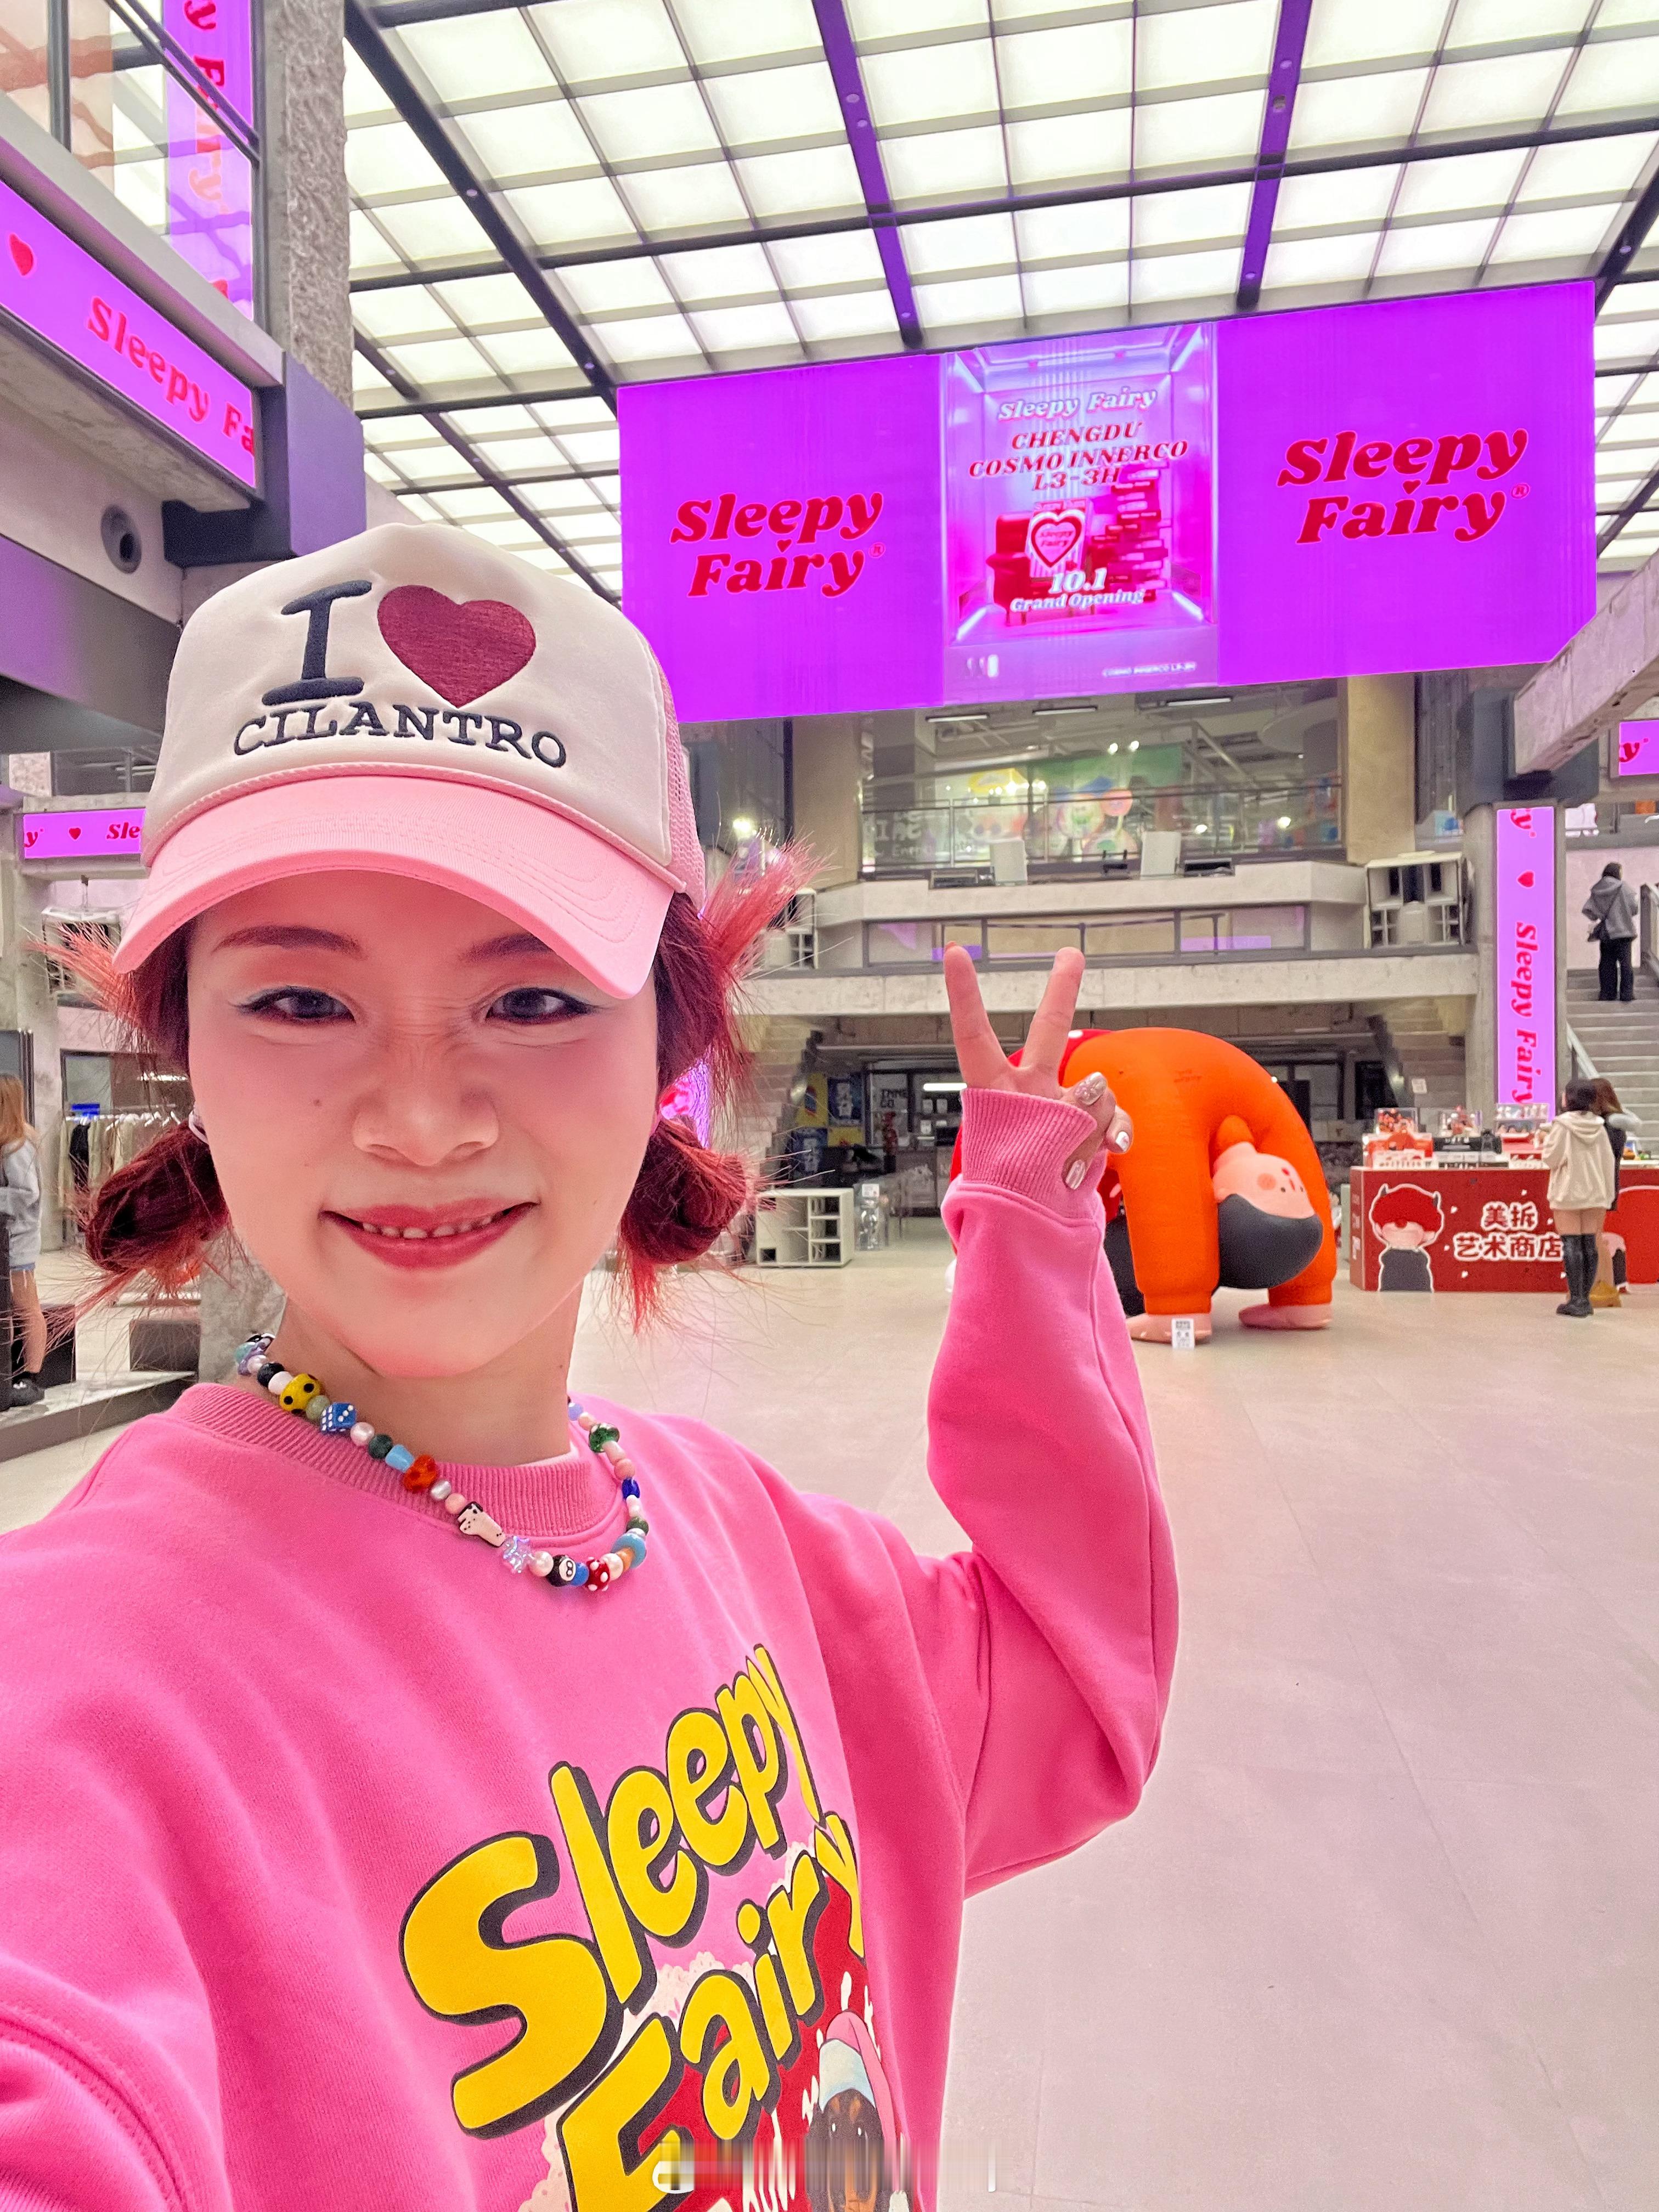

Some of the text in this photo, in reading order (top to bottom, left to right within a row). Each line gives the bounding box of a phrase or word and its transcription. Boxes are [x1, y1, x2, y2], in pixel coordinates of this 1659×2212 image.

[87, 296, 211, 422] Sleepy
[999, 387, 1157, 420] Sleepy Fairy
[969, 440, 1188, 477] COSMO INNERCO
[1011, 421, 1142, 450] CHENGDU
[1277, 429, 1527, 486] Sleepy
[670, 493, 883, 544] Sleepy
[1010, 589, 1146, 612] Grand Opening
[1049, 568, 1107, 594] 10.1
[262, 579, 372, 706] I
[233, 701, 567, 769] CILANTRO
[1511, 922, 1538, 1018] Sleepy
[1482, 1202, 1537, 1230] 美拆
[1454, 1233, 1564, 1261] 艺术商店
[398, 1643, 823, 2138] Sleepy
[556, 1810, 867, 2212] Fairy
